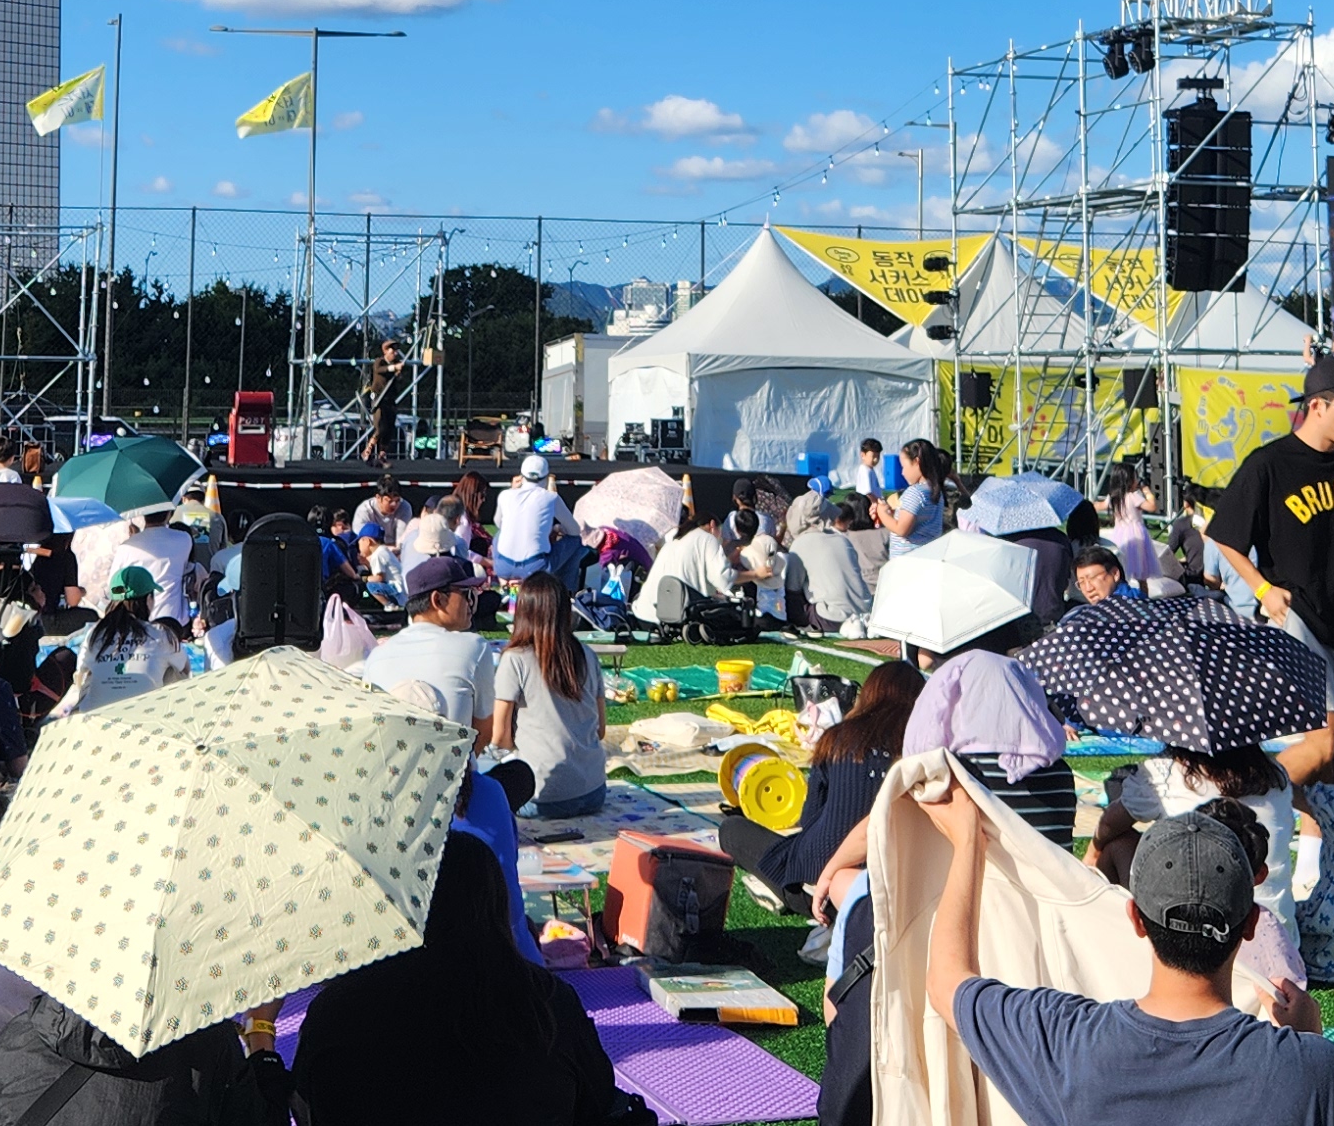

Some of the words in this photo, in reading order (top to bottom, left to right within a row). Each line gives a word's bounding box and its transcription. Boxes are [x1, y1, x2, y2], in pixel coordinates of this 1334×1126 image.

[871, 250, 915, 268] 동작
[869, 269, 931, 286] 서커스
[237, 416, 265, 426] POST
